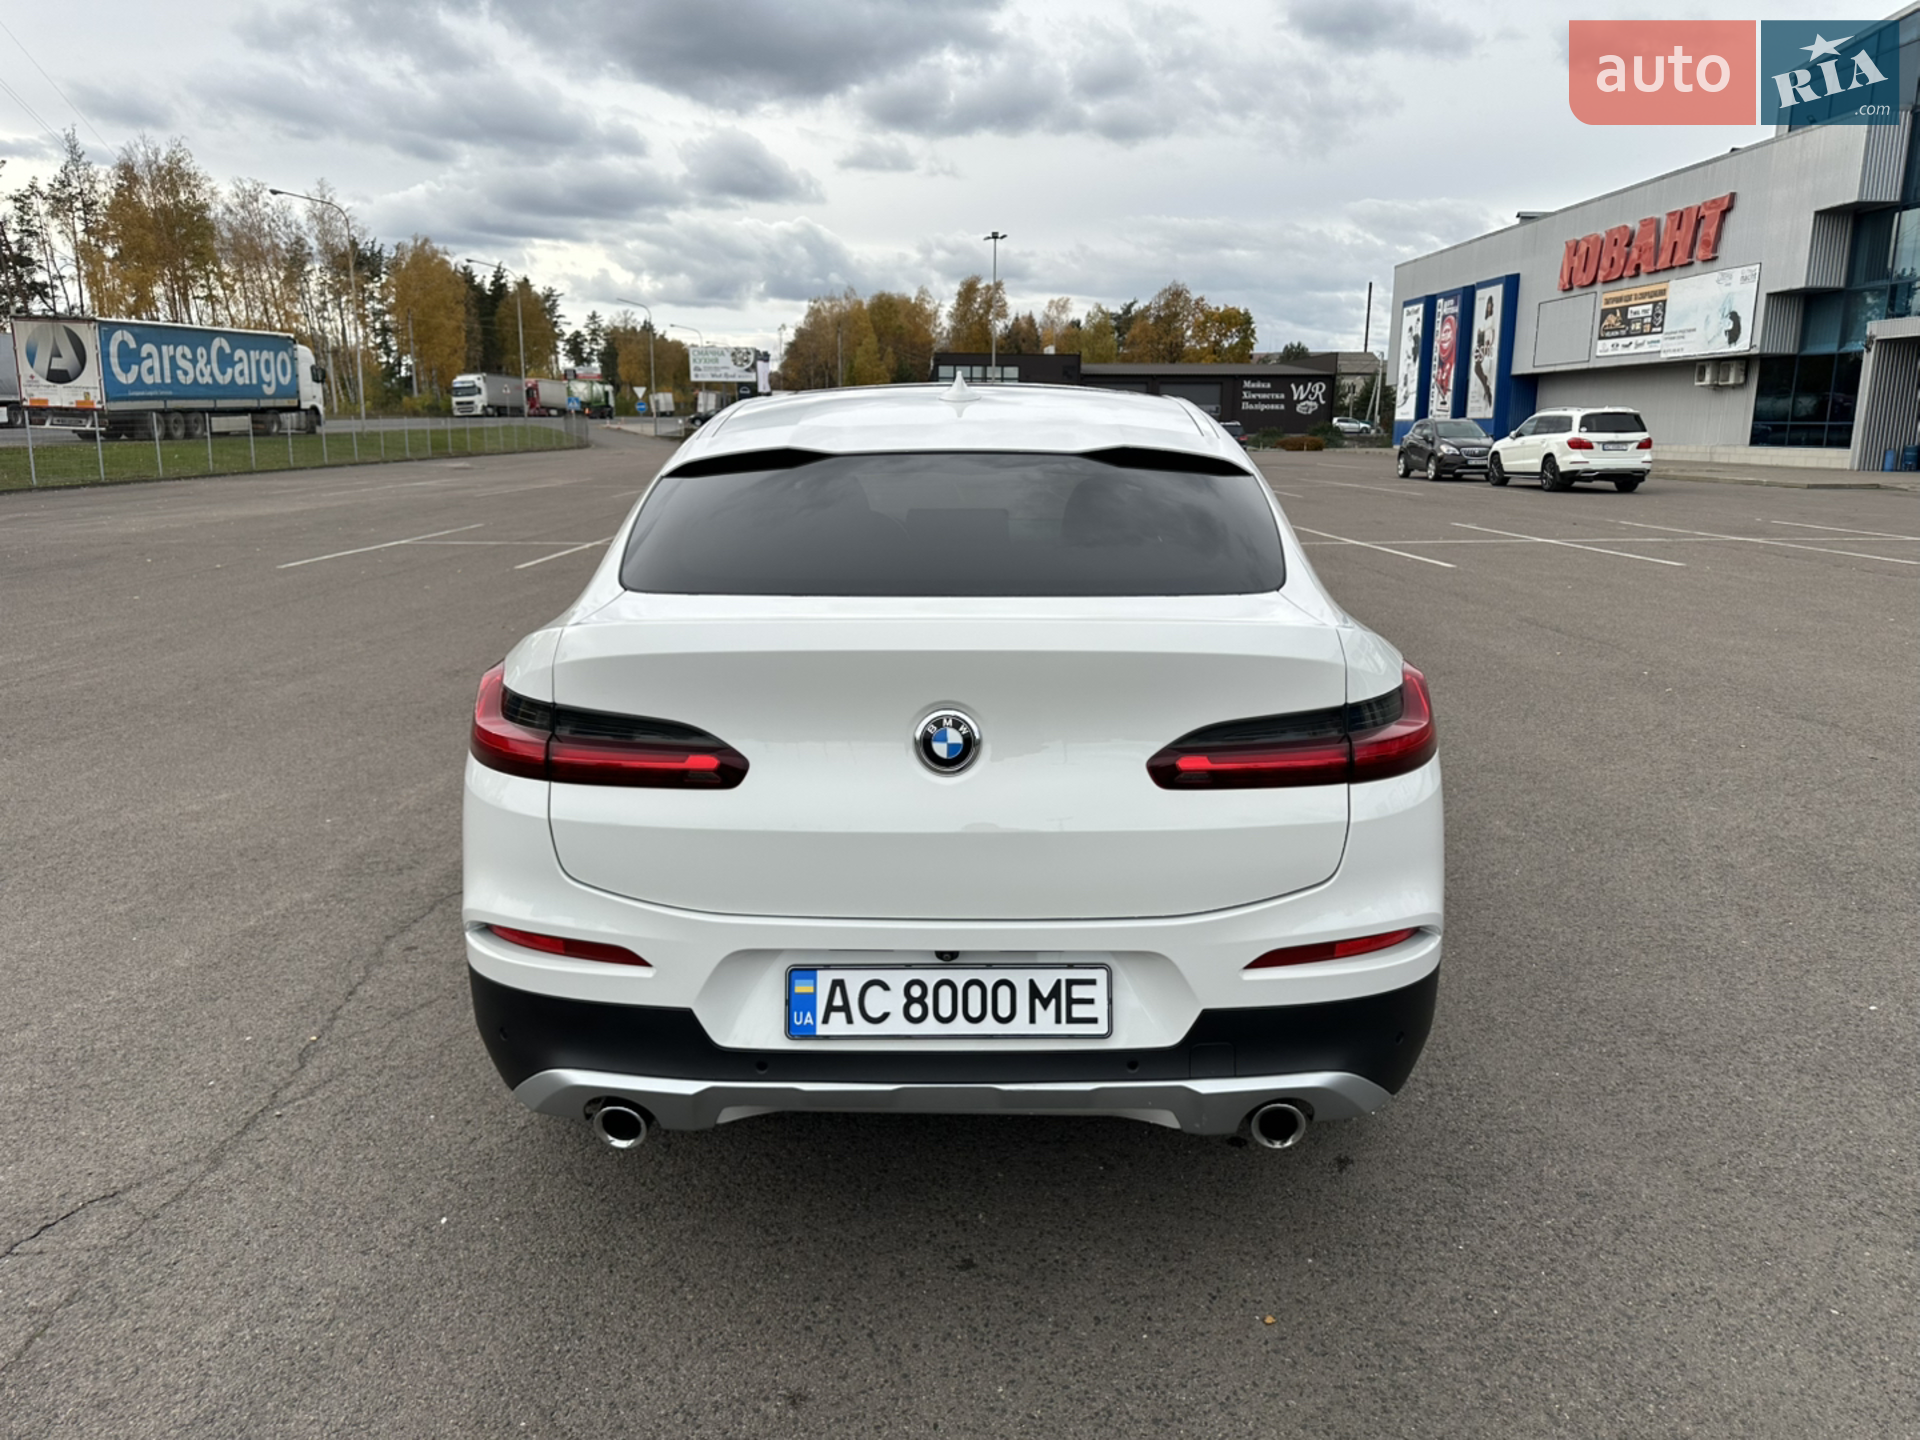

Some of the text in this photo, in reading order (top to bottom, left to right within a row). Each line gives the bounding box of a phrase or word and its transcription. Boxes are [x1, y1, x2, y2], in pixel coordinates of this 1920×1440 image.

[109, 329, 293, 395] Cars&Cargo
[1243, 380, 1271, 388] Мийка
[1242, 391, 1285, 399] Хімчистка
[1290, 382, 1326, 404] WR
[1241, 402, 1285, 411] Поліровка
[927, 718, 969, 735] BMW
[821, 978, 1099, 1025] AC 8000 ME
[794, 1011, 814, 1026] UA
